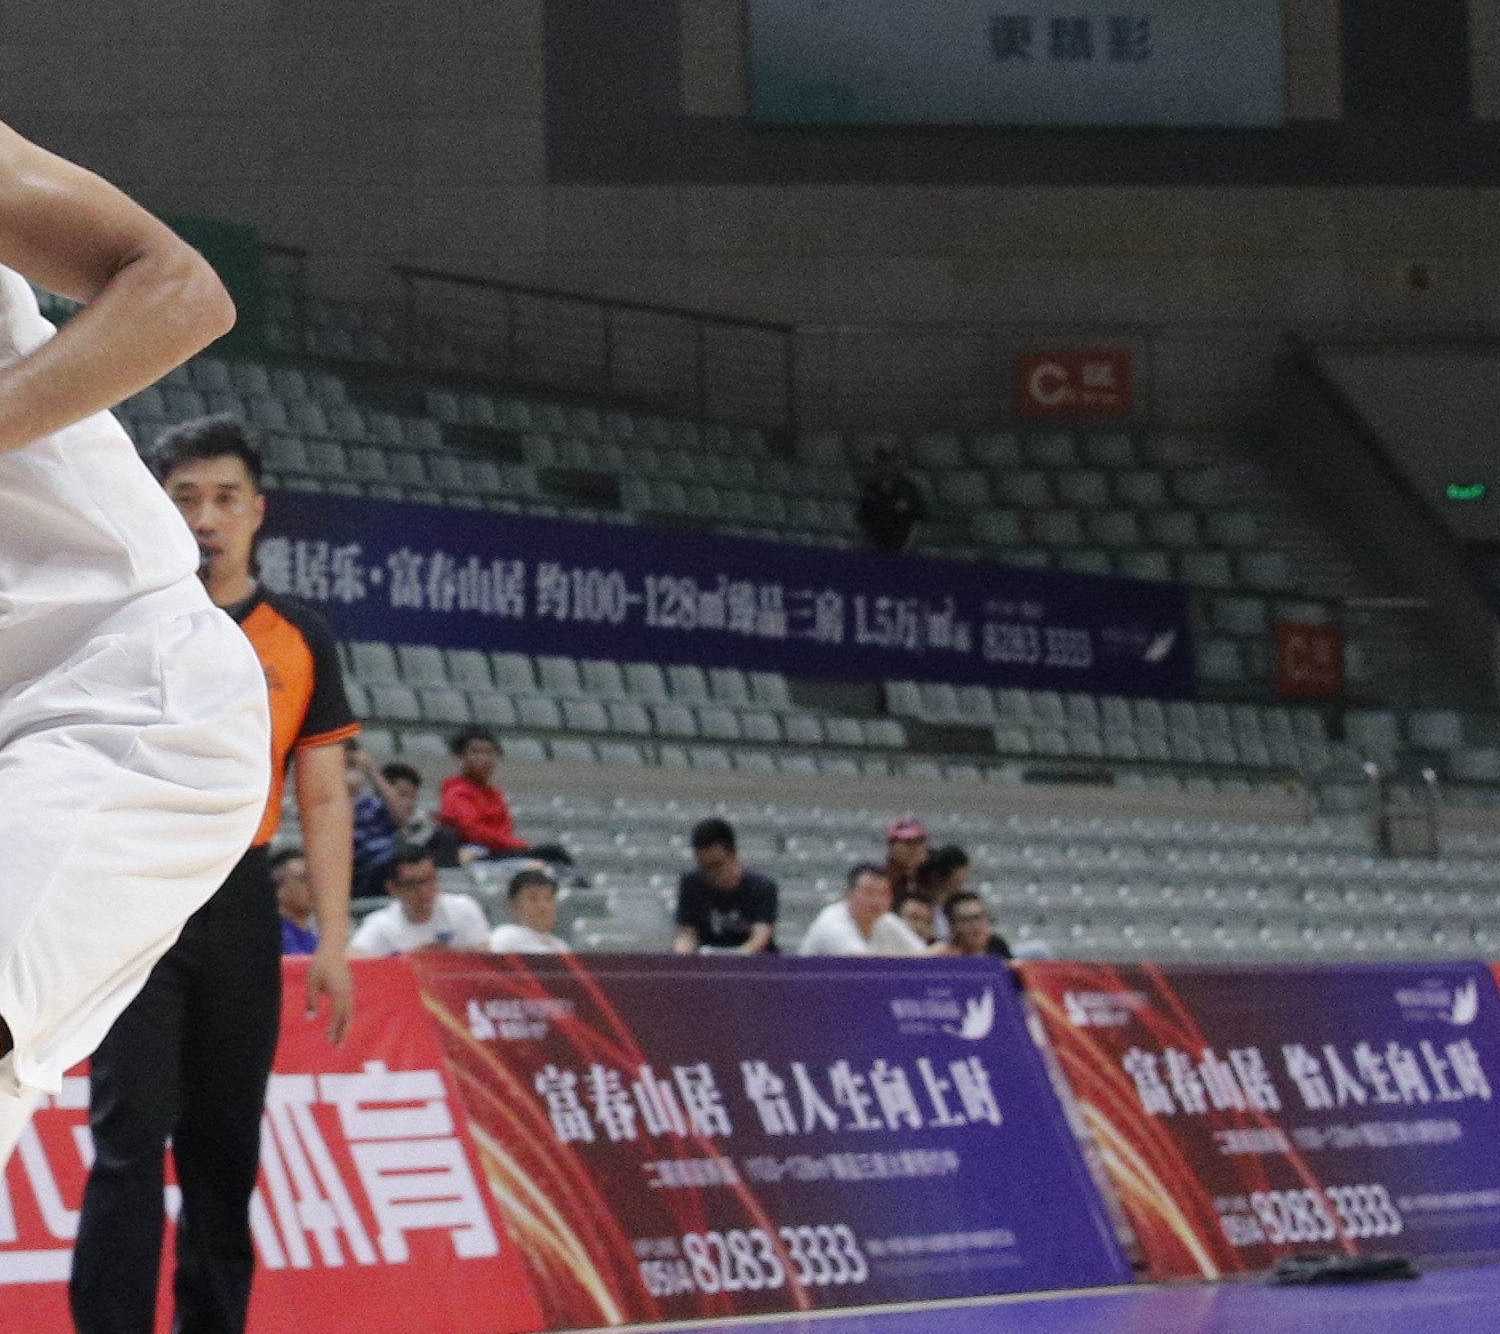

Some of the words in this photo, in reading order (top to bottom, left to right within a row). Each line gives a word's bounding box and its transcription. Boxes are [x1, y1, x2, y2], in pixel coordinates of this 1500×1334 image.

[533, 1062, 733, 1145] 富春山居
[1121, 1044, 1283, 1117] 富春山居
[1250, 1188, 1337, 1245] 8283
[1324, 1182, 1404, 1239] 3333
[682, 1230, 786, 1294] 8283
[779, 1223, 870, 1286] 3333
